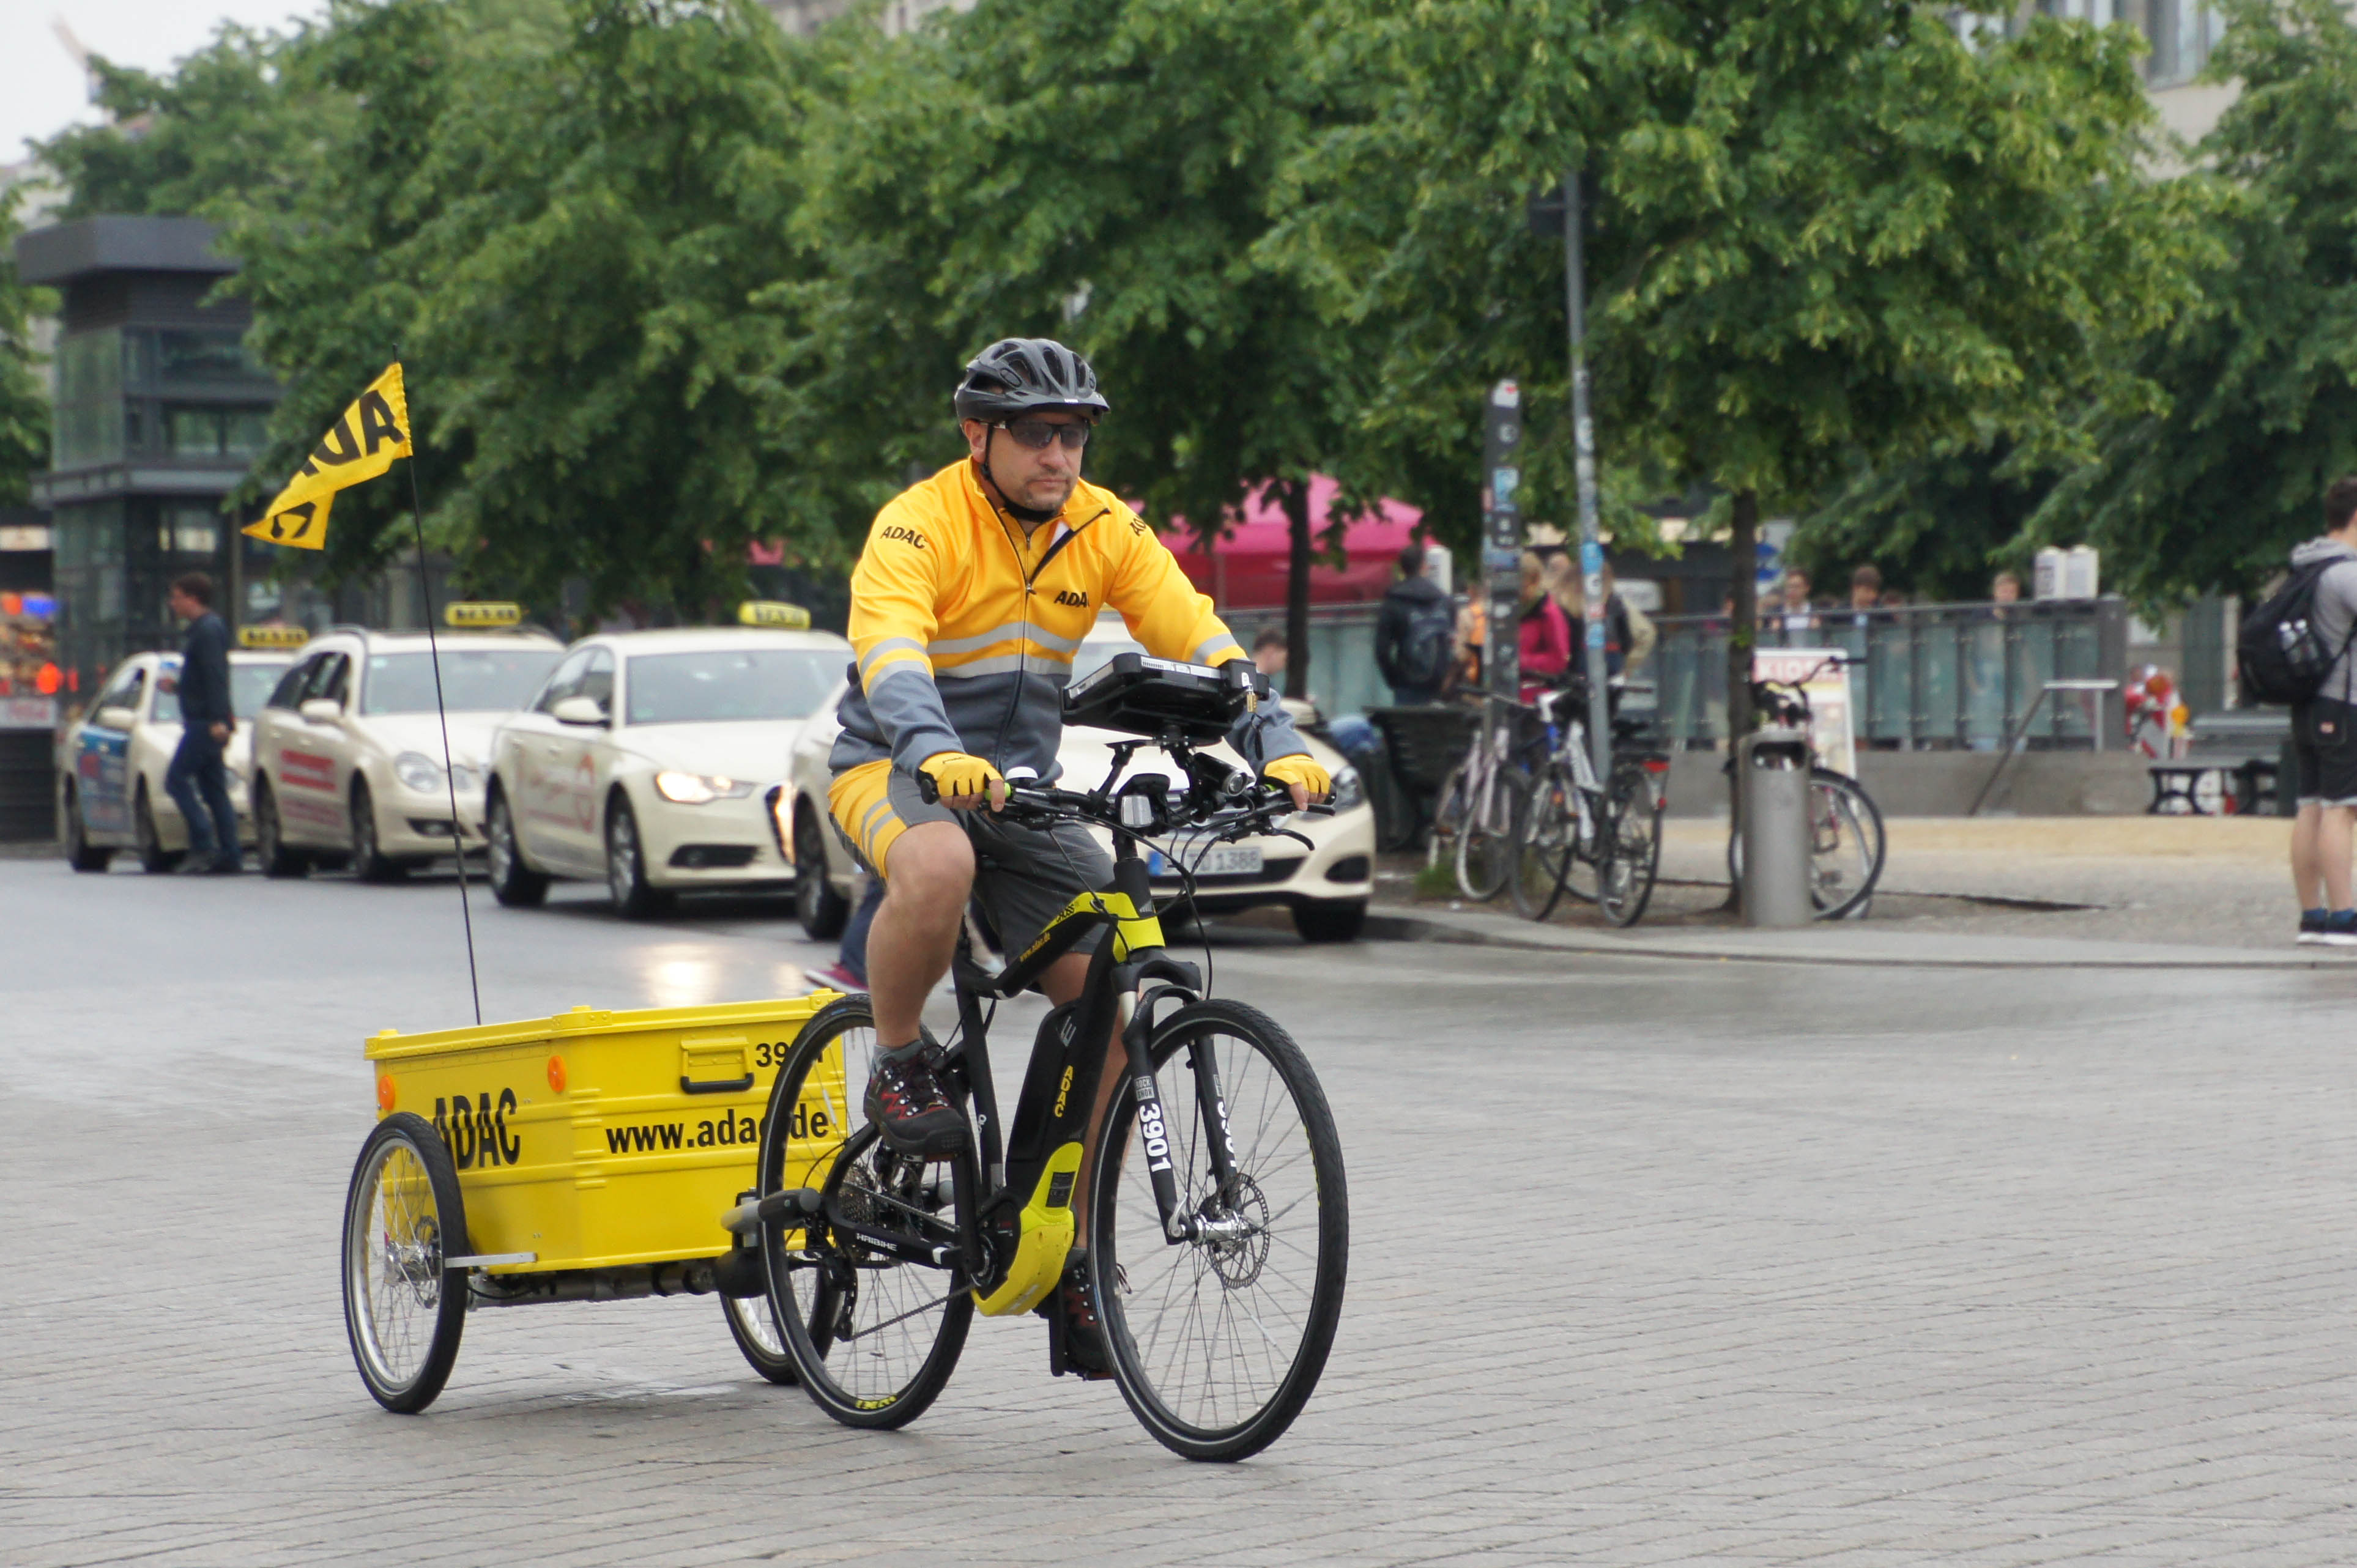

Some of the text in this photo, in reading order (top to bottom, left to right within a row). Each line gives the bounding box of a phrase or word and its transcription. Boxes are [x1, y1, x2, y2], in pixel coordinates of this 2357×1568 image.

[880, 526, 928, 549] ADAC
[1055, 1065, 1074, 1118] ADAC
[432, 1087, 521, 1170] ADAC
[606, 1103, 830, 1154] www.adade
[1139, 1103, 1172, 1173] 3901
[856, 1232, 899, 1252] HAIBIKE
